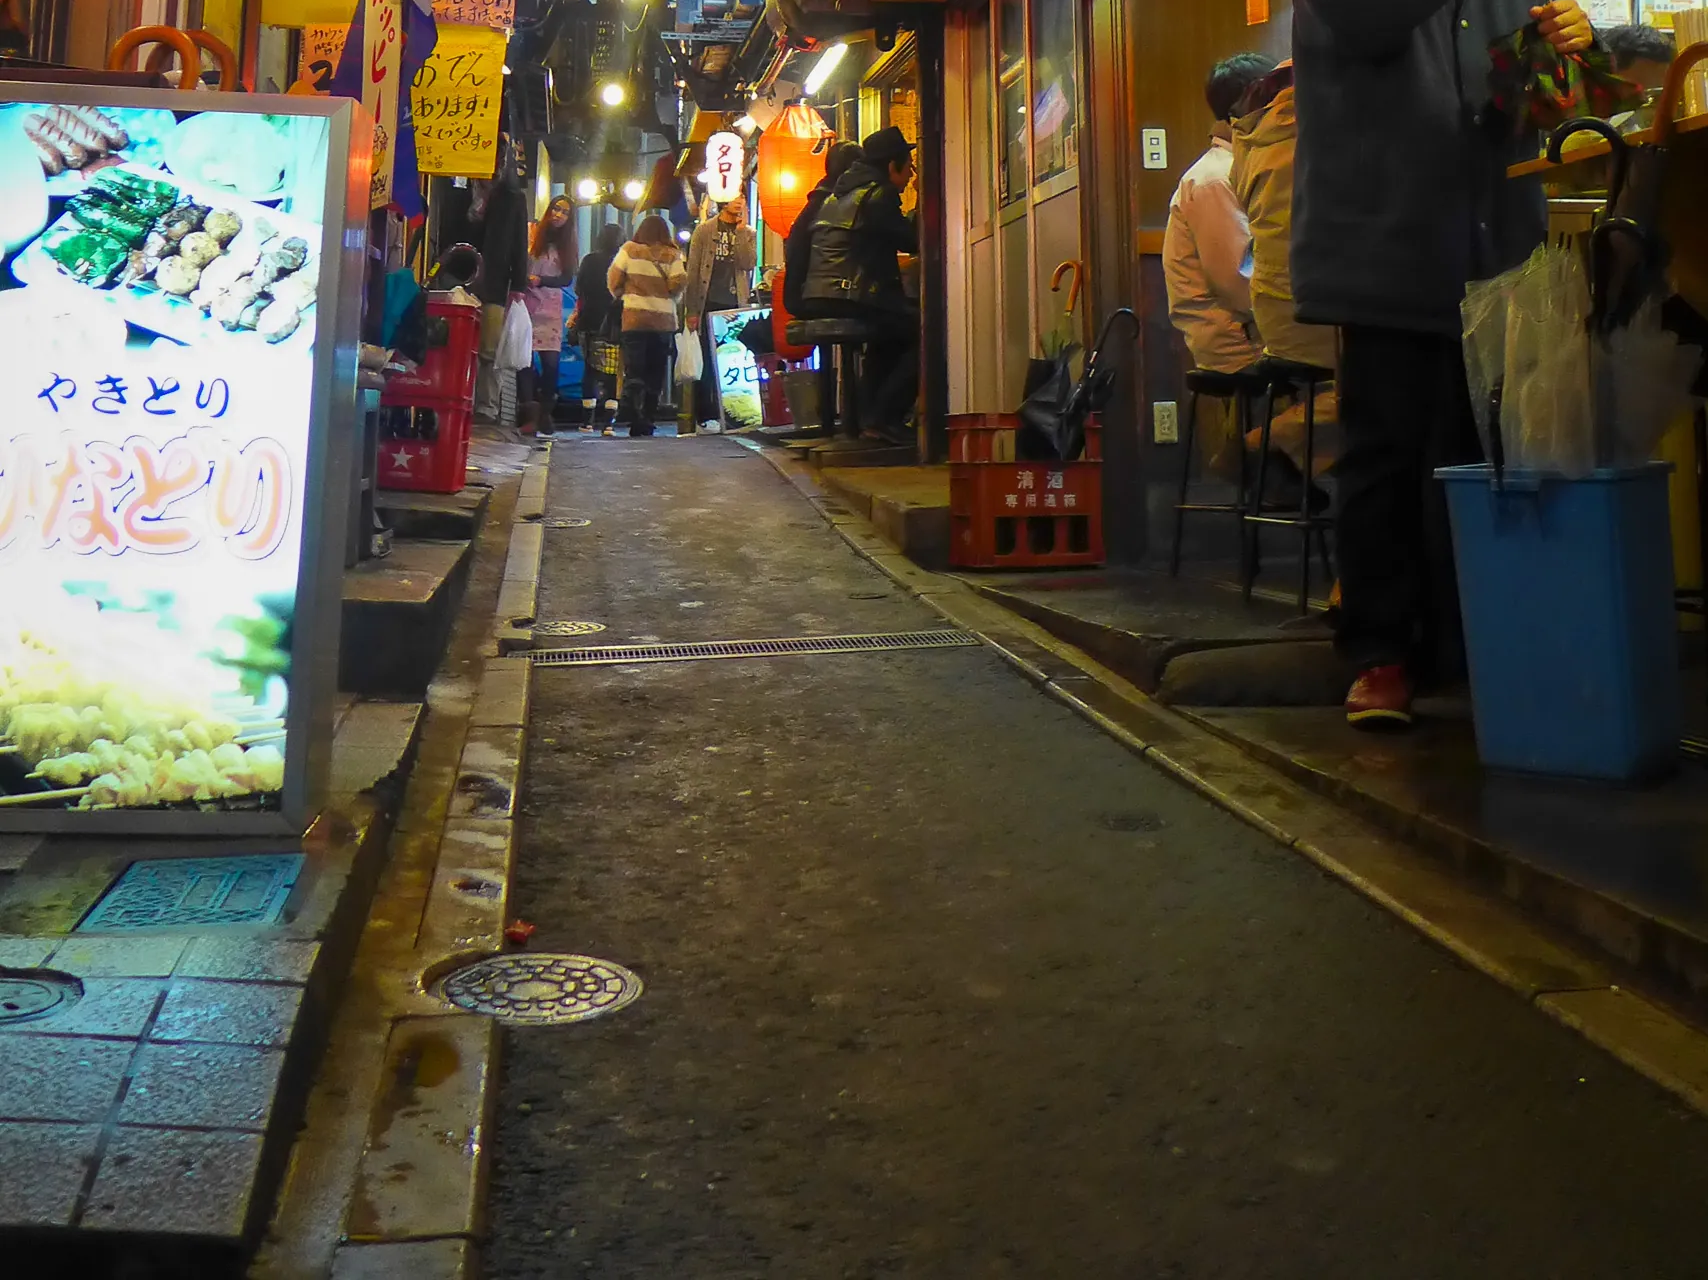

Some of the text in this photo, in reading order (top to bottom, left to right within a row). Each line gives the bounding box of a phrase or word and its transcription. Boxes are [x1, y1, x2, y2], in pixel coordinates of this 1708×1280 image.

[413, 51, 487, 89] おでん
[718, 143, 734, 189] タロー
[38, 371, 229, 418] やきとり
[1016, 470, 1064, 489] 清酒
